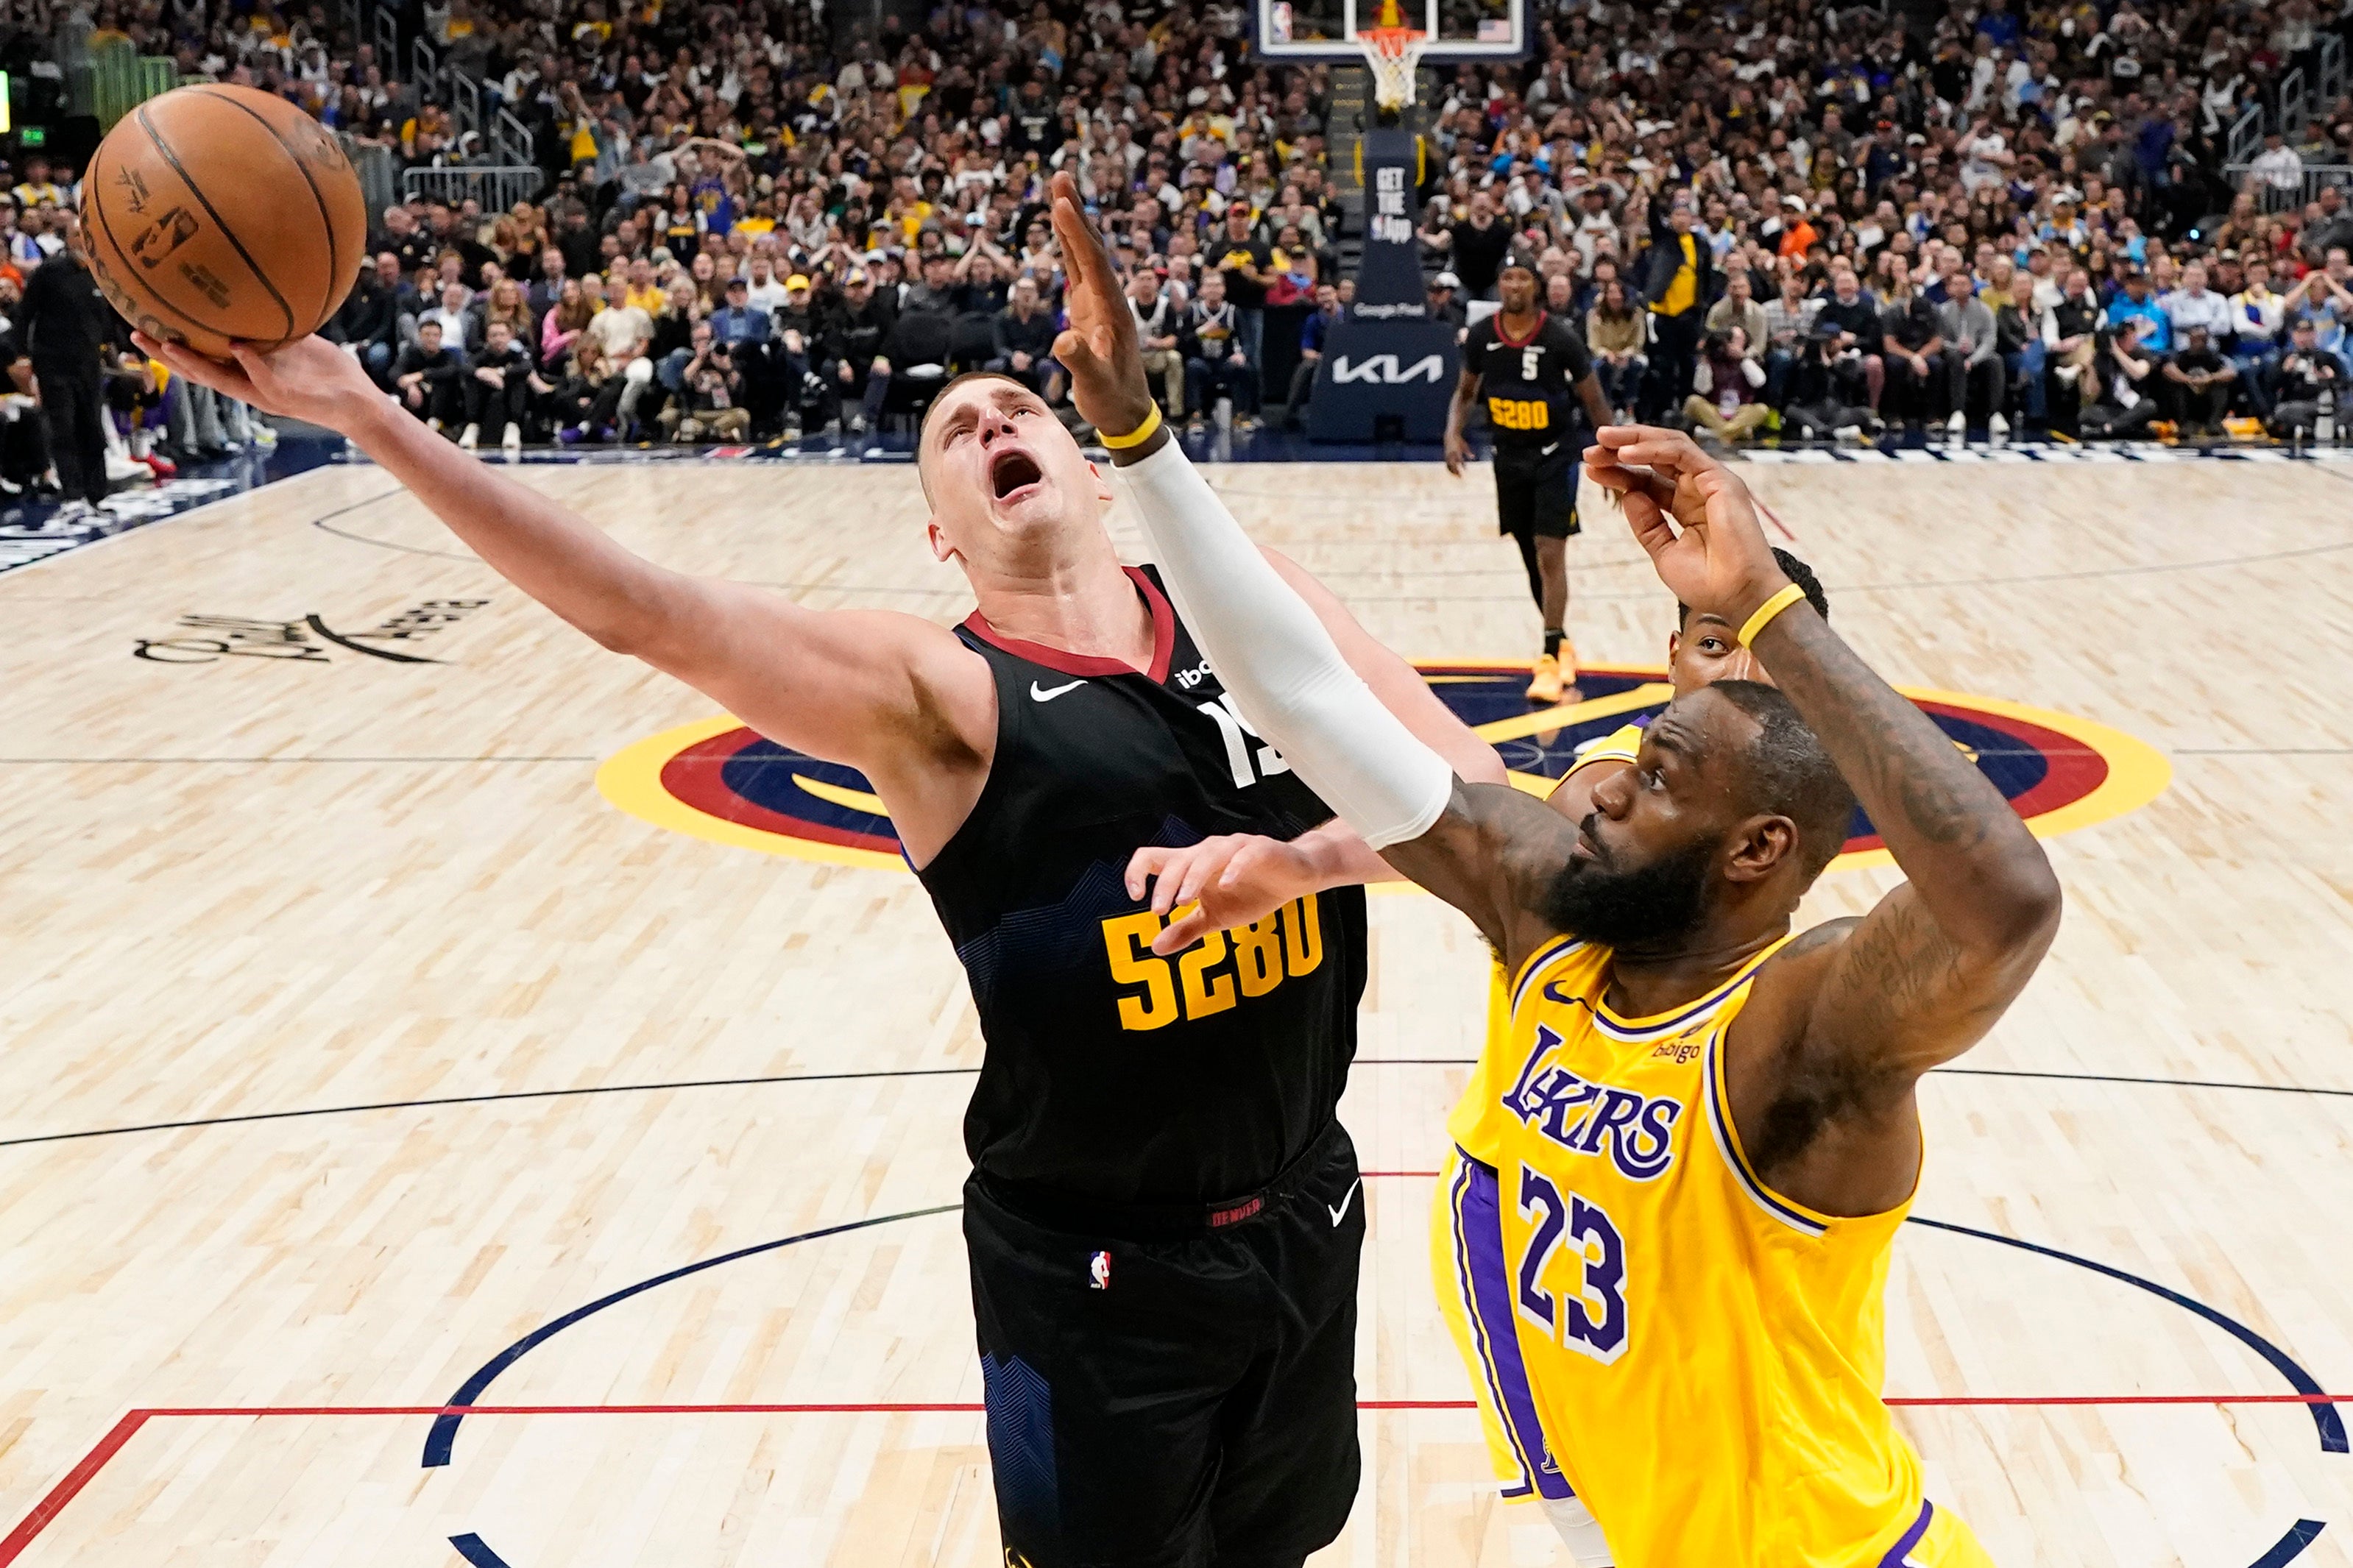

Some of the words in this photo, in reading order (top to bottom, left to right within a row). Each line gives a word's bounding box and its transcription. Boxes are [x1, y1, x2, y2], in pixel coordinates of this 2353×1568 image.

[1376, 167, 1406, 191] GET
[1377, 191, 1406, 215] THE
[1521, 352, 1539, 380] 5
[1488, 397, 1549, 430] 5280
[1102, 893, 1323, 1031] 5280
[1211, 1198, 1261, 1228] DENVER
[1518, 1163, 1629, 1366] 23
